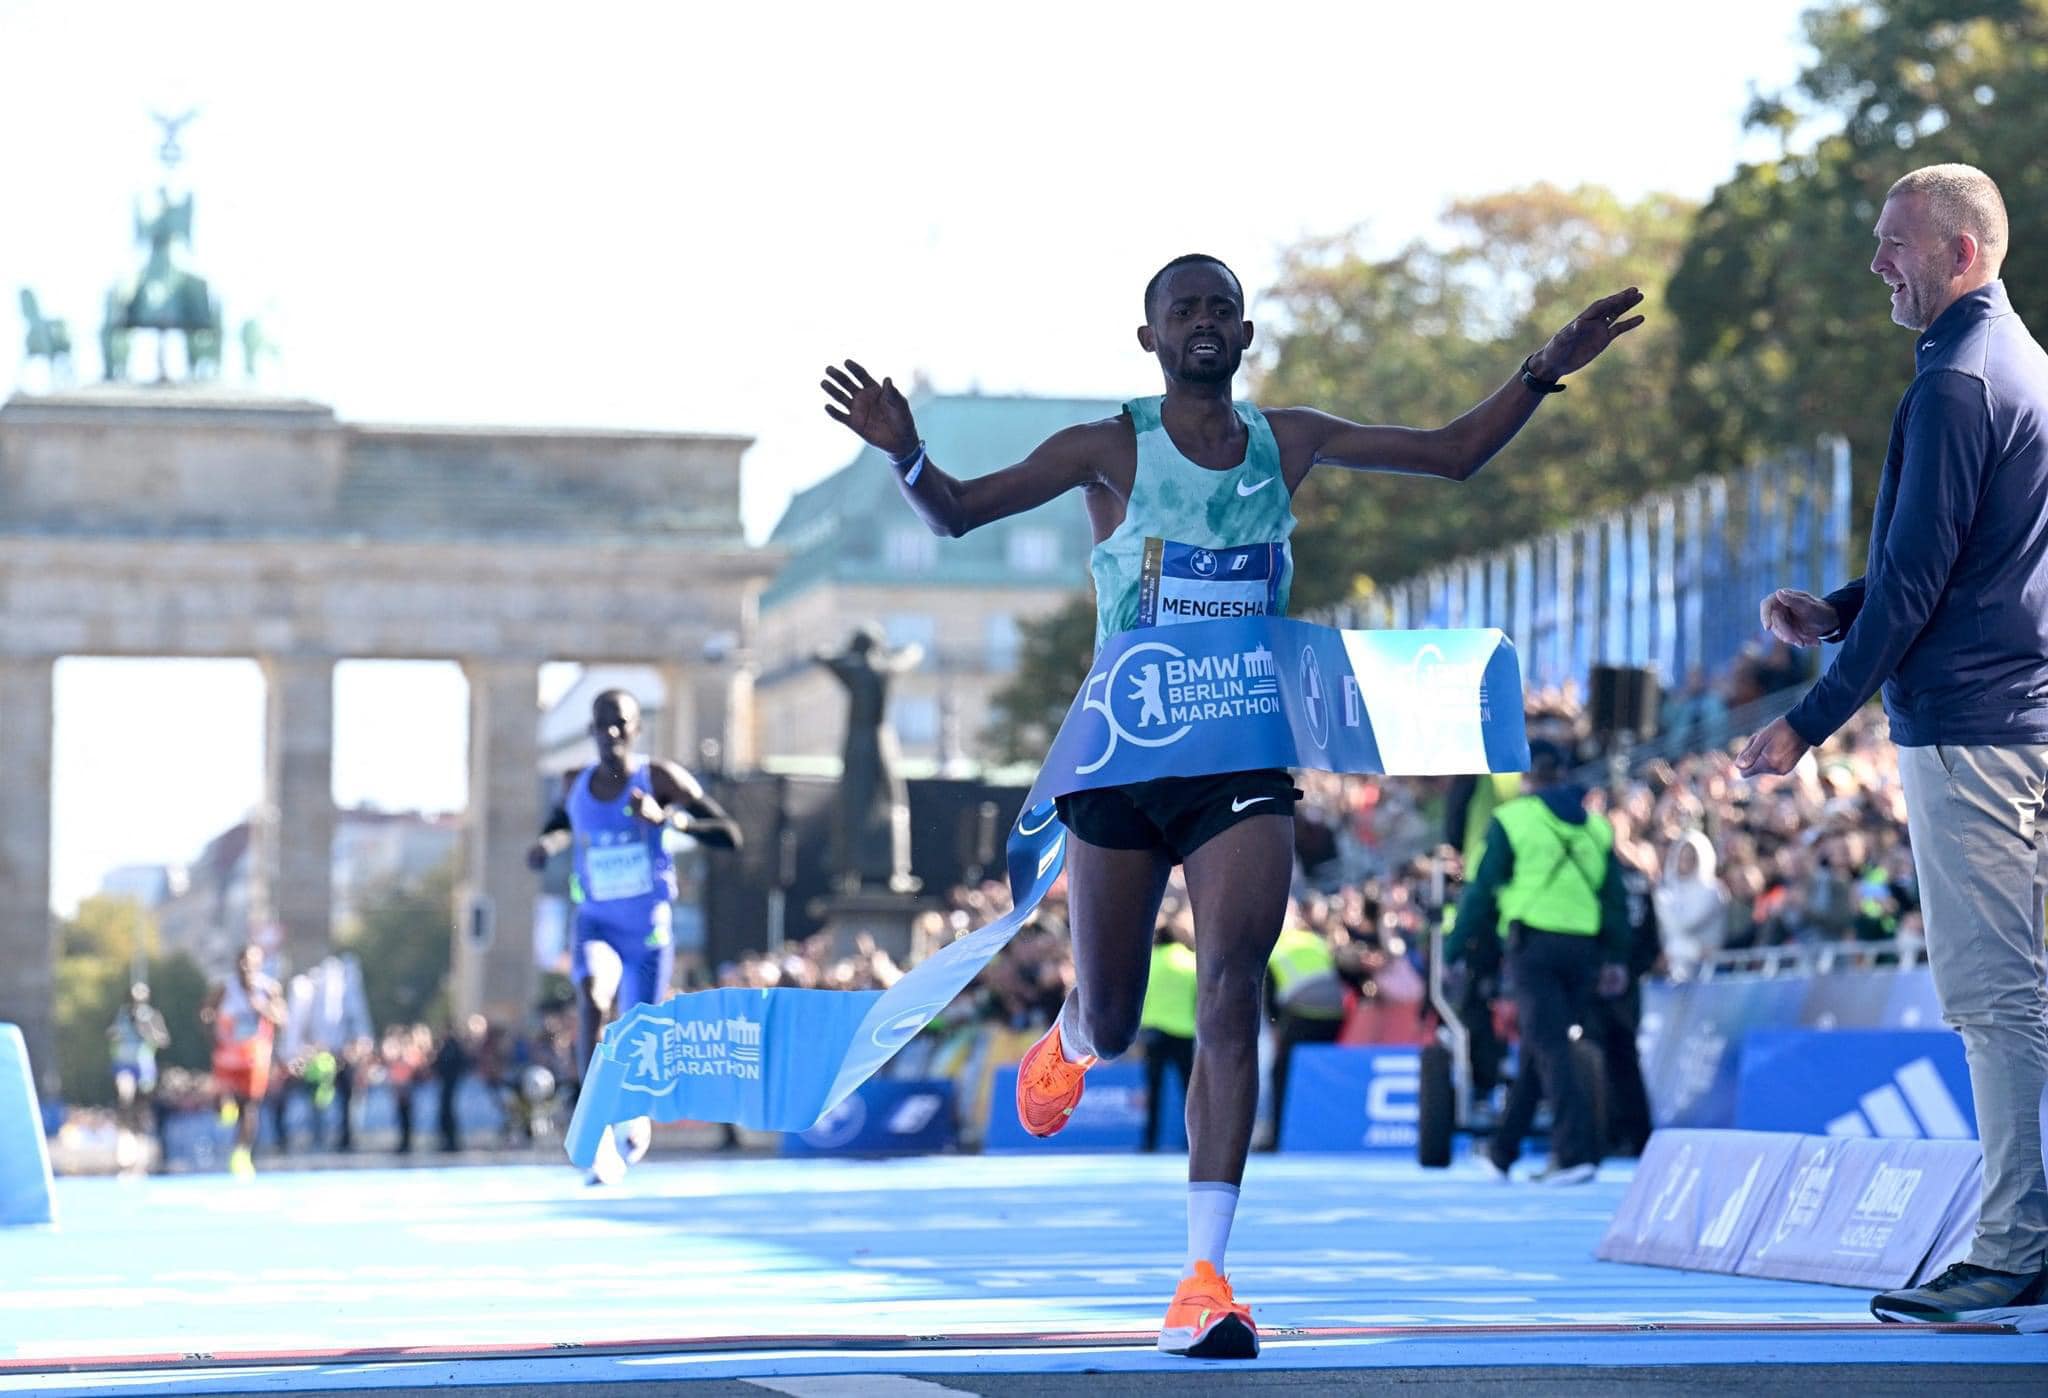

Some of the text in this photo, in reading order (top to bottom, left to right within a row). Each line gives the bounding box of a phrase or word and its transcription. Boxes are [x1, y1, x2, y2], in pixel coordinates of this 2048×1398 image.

[1162, 597, 1265, 618] MENGESHA
[1165, 653, 1240, 685] BMW
[1168, 680, 1245, 704] BERLIN
[1170, 697, 1280, 724] MARATHON
[663, 1043, 726, 1066] BERLIN
[664, 1060, 760, 1080] MARATHON
